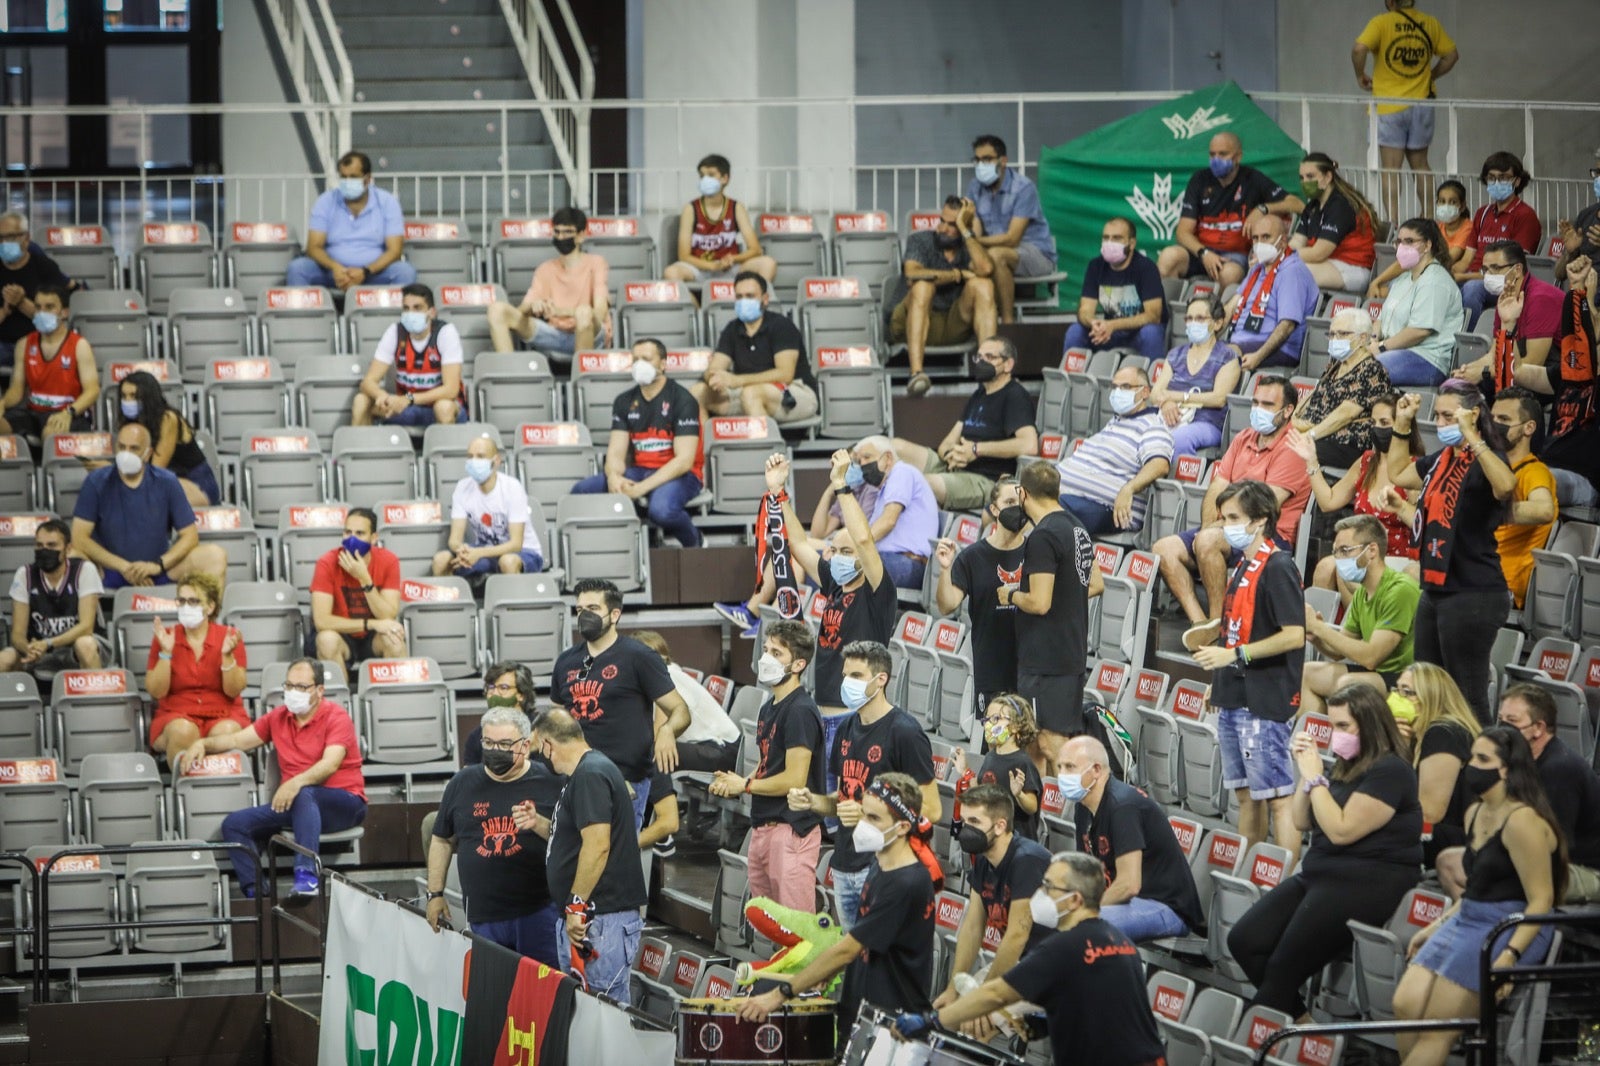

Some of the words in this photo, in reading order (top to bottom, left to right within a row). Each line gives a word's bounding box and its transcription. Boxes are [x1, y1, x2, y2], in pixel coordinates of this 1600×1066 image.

[1394, 22, 1424, 32] STA
[763, 218, 777, 229] NO
[914, 217, 928, 228] NO
[629, 287, 643, 297] NO
[714, 285, 728, 296] NO
[809, 283, 824, 294] NO
[826, 283, 854, 294] USA
[445, 290, 460, 301] NO
[1370, 306, 1379, 317] NO
[582, 355, 597, 366] NO
[821, 351, 836, 362] NO
[716, 421, 731, 433] NO
[526, 428, 540, 440] NO
[58, 438, 75, 450] NO
[255, 440, 270, 451] NO
[1179, 458, 1188, 470] NO
[387, 508, 402, 519] NO
[1096, 548, 1105, 560] NO
[1132, 555, 1142, 567] NO
[404, 583, 420, 596] NO
[422, 587, 456, 599] USA
[32, 611, 79, 637] SIXER
[906, 620, 915, 632] NO
[939, 627, 948, 639] NO
[1542, 655, 1554, 668] NO
[372, 666, 389, 679] NO
[1101, 670, 1111, 682] NO
[69, 675, 85, 688] NO
[88, 674, 121, 686] USAR
[1140, 678, 1149, 690] NO
[1178, 693, 1188, 705] NO
[1307, 722, 1317, 736] NO
[203, 757, 236, 769] USAR
[1044, 788, 1054, 801] NO
[1214, 841, 1225, 854] NO
[60, 860, 94, 872] USAR
[1256, 859, 1267, 872] NO
[940, 902, 949, 915] NO
[1414, 900, 1426, 914] NO
[644, 950, 653, 962] NO
[678, 962, 688, 975] NO
[709, 981, 719, 994] NO
[1157, 991, 1168, 1006] NO
[1254, 1021, 1265, 1036] NO
[1304, 1037, 1316, 1051] NO
